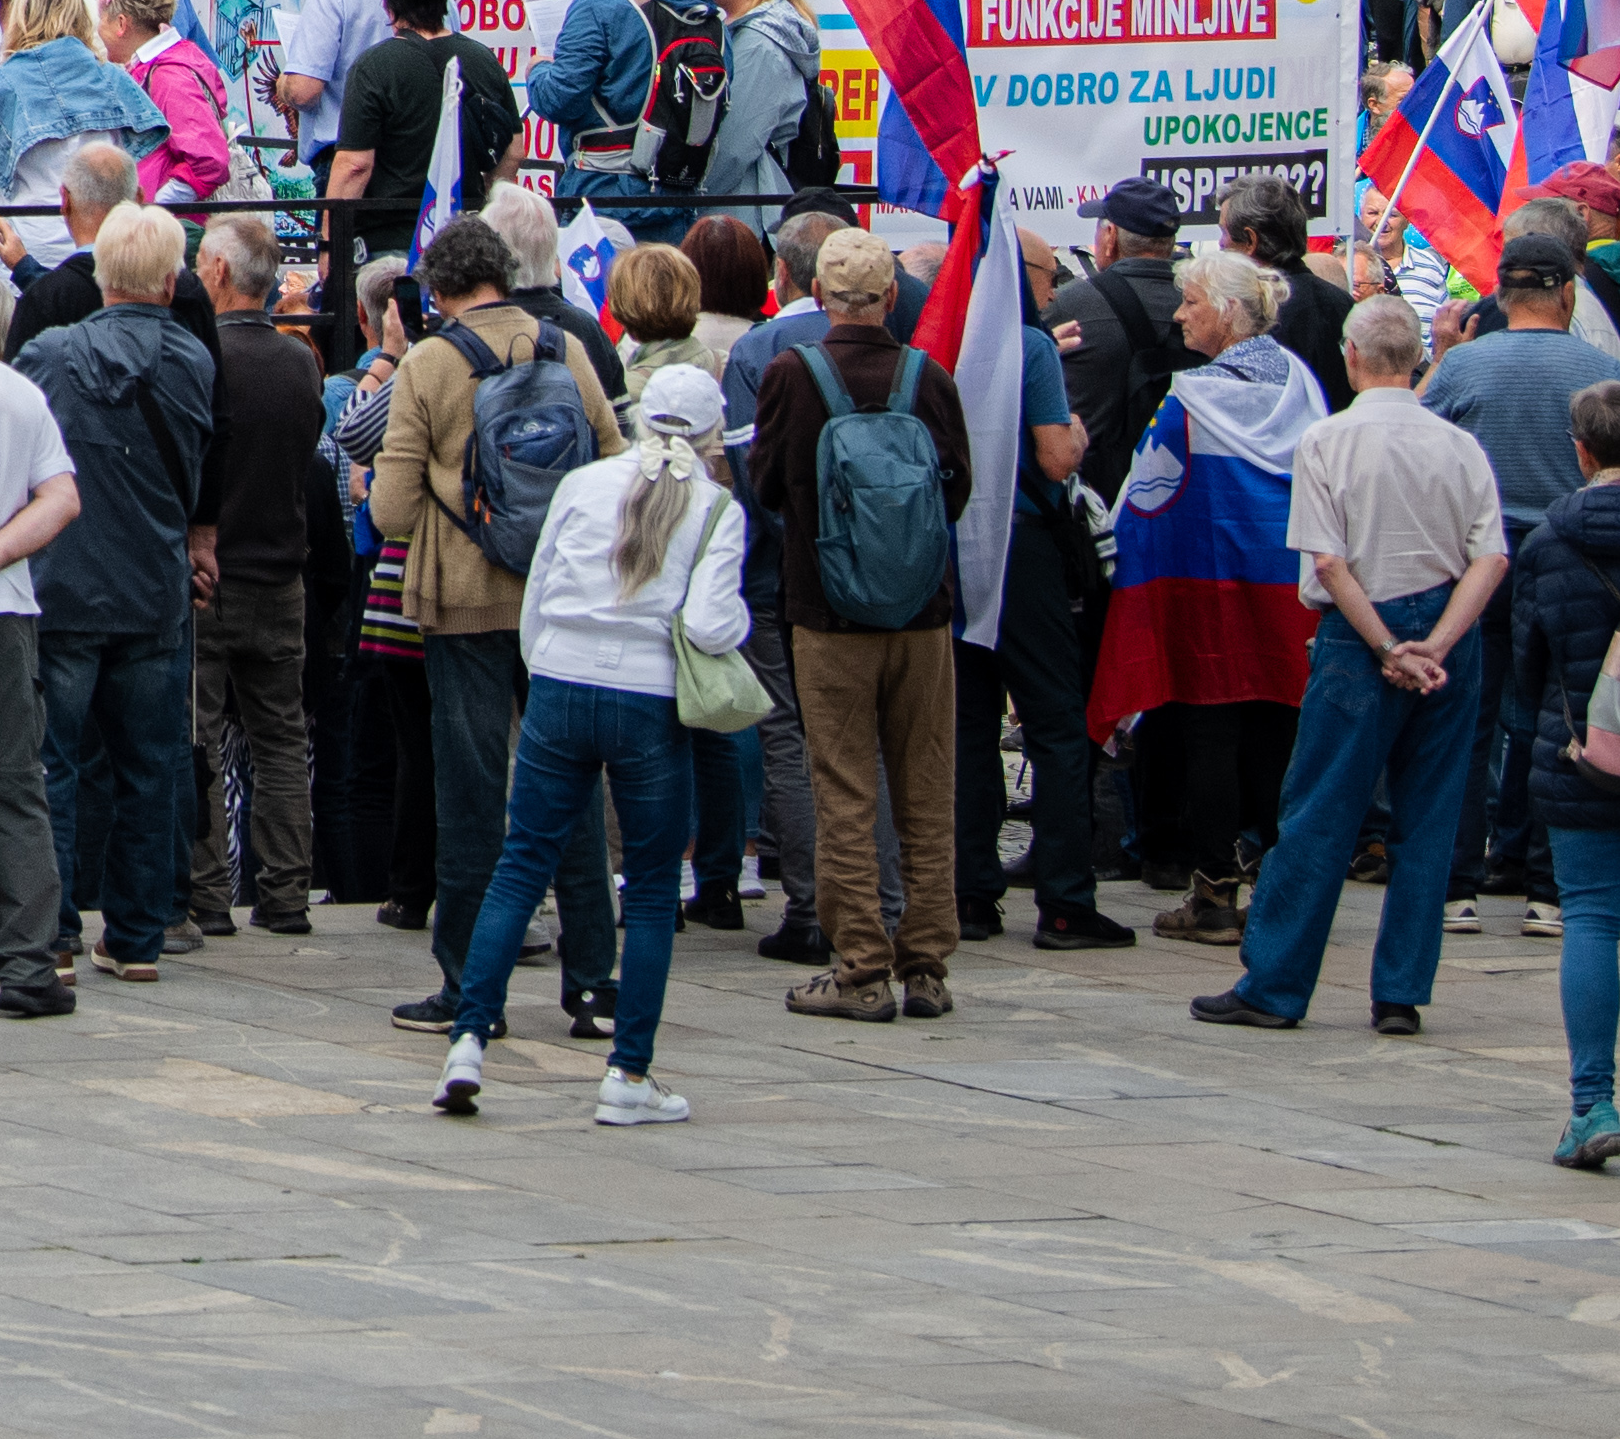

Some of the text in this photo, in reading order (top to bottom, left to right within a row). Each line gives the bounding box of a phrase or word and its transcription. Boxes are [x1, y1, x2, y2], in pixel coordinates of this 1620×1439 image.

[974, 74, 998, 108] V
[1006, 71, 1120, 107] DOBRO
[1128, 69, 1174, 104] ZA
[1184, 66, 1276, 102] LJUDI
[1143, 107, 1329, 147] UPOKOJENCE
[1023, 186, 1065, 210] VAMI
